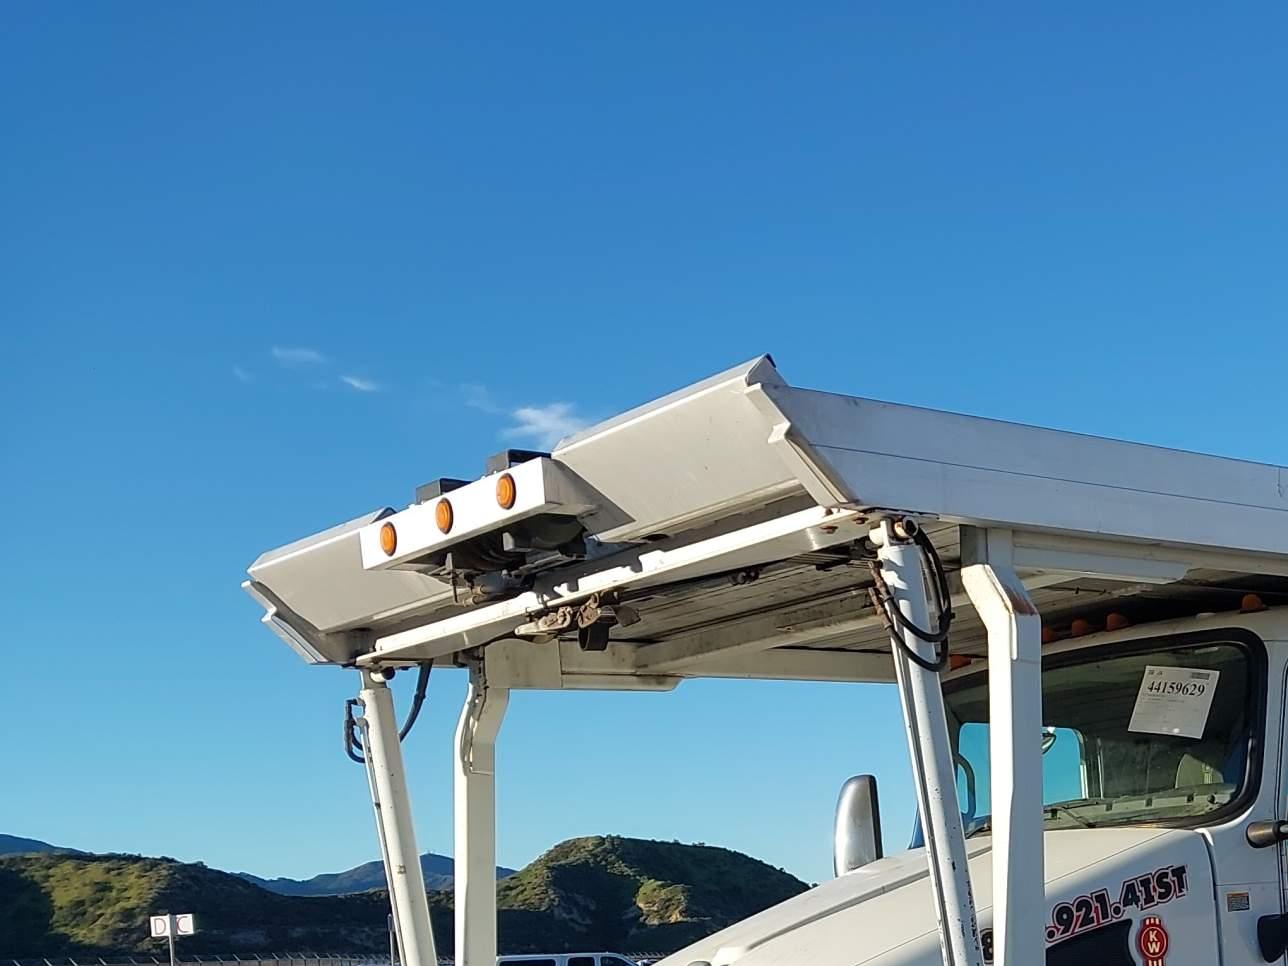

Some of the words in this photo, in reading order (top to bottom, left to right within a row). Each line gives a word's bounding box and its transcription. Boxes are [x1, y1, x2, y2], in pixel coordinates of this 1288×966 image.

[1147, 680, 1205, 697] 44159629
[154, 917, 166, 935] D
[176, 916, 189, 933] C
